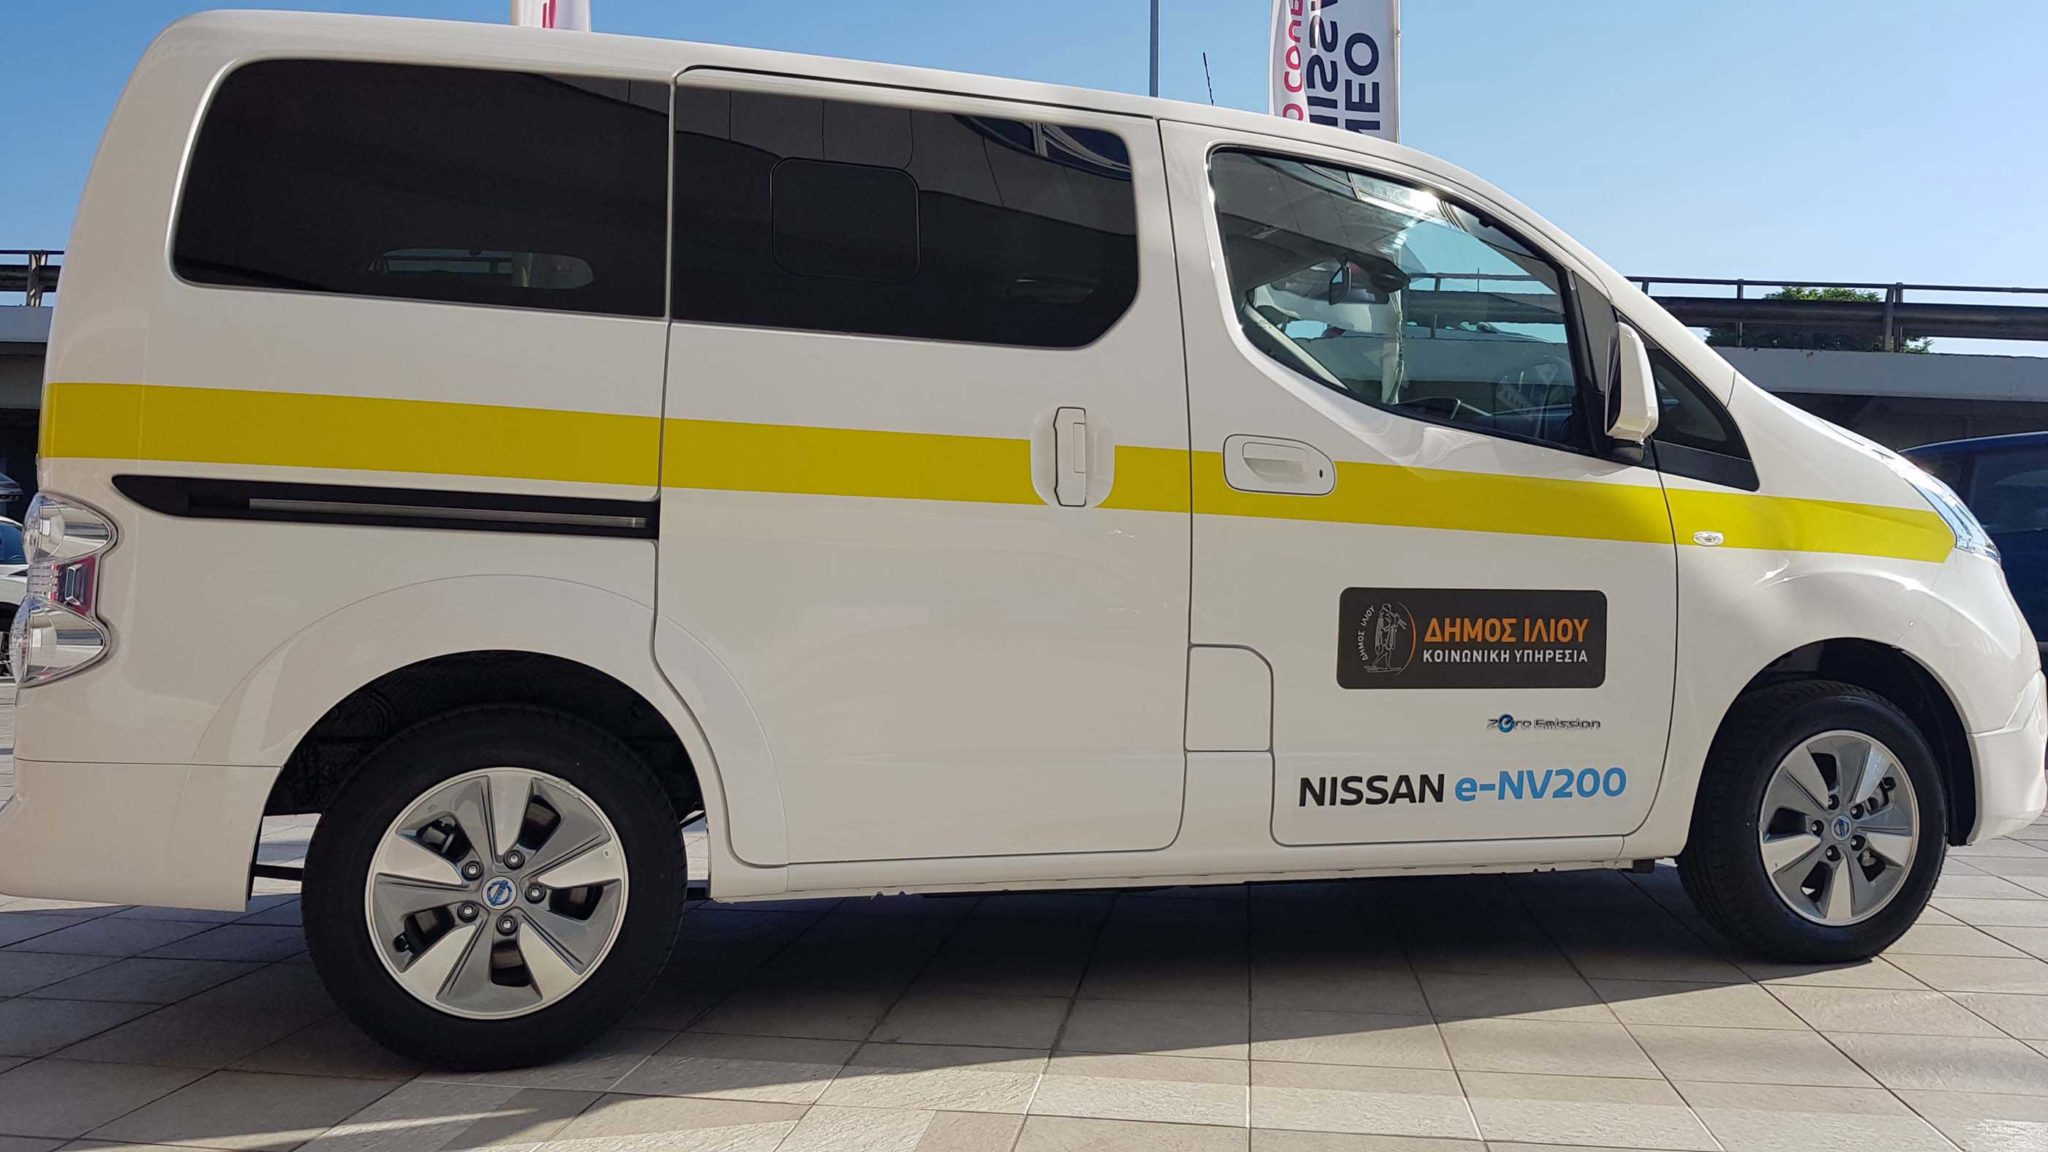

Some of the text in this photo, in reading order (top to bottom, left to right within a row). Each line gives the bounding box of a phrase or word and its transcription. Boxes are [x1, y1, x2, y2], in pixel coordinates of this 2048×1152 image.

[1424, 617, 1589, 643] ΔΗΜΟΣ ΙΛΙΟΥ
[1423, 650, 1588, 663] ΚΟΙΝΩΝΙΚΗ ΥΠΗΡΕΣΙΑ
[1534, 717, 1601, 731] Emission
[1298, 767, 1627, 807] NISSAN e-NV200
